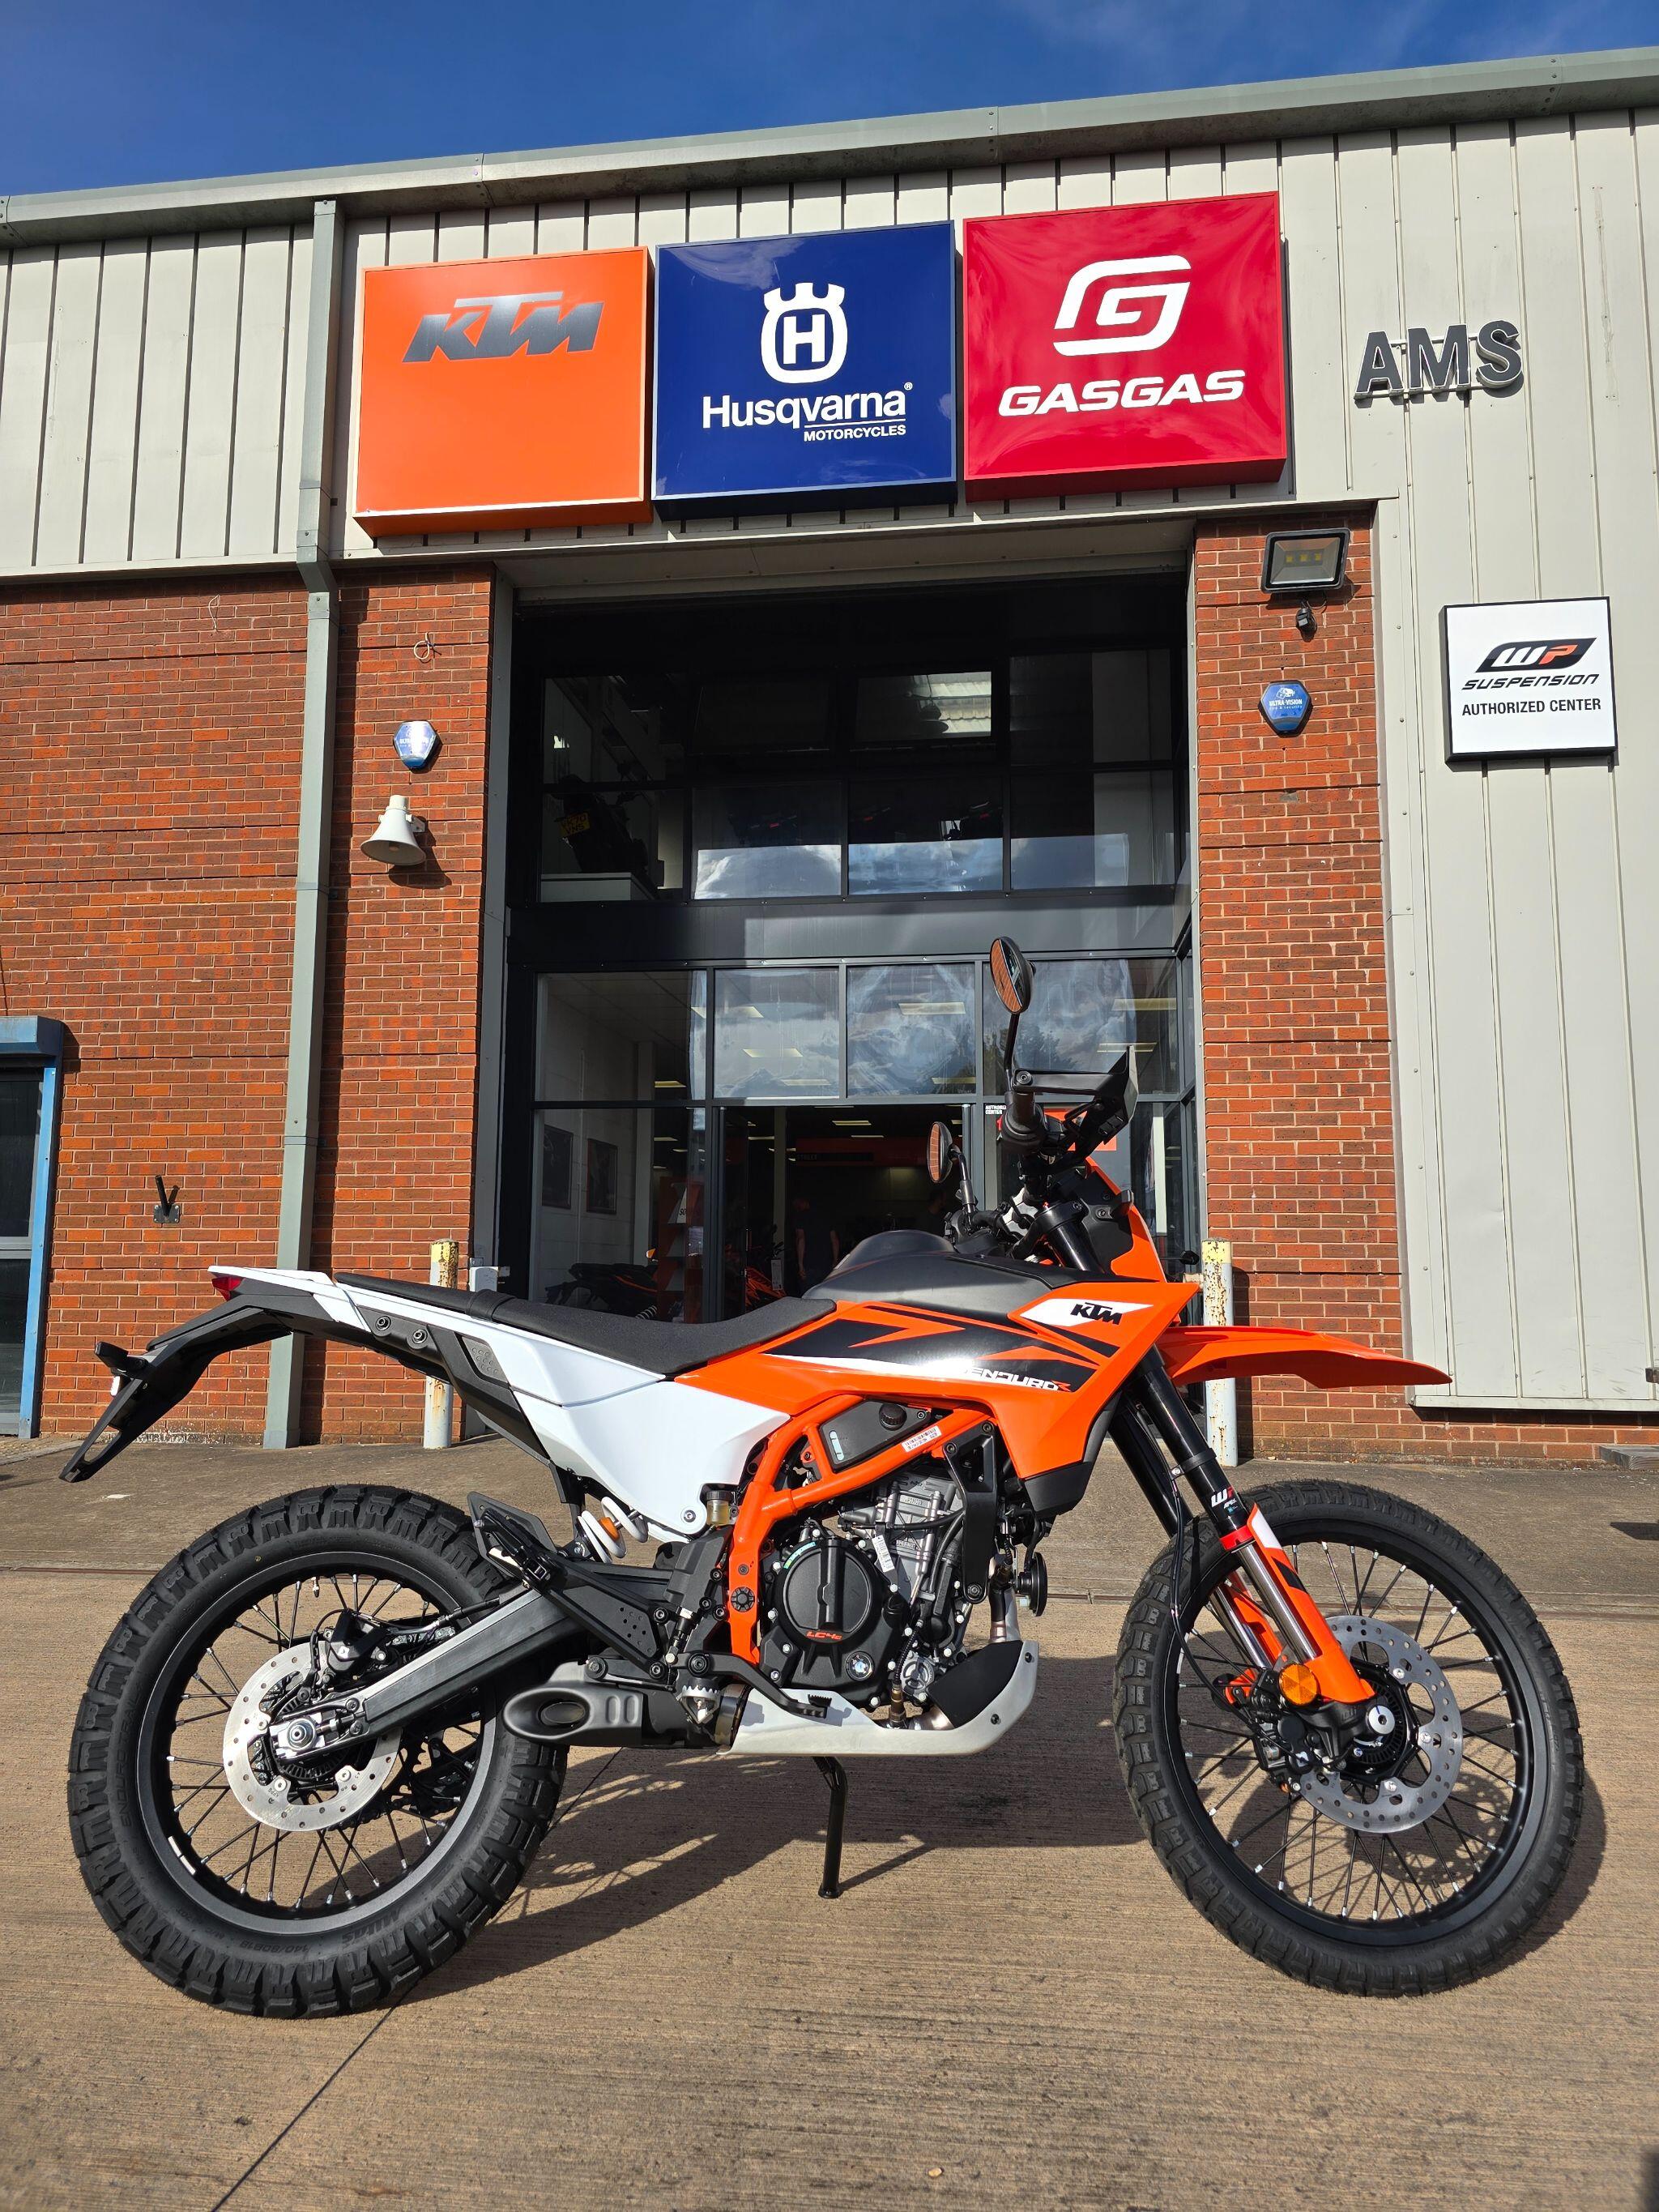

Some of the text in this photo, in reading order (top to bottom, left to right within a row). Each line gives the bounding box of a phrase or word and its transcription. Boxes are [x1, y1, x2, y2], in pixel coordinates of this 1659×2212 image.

[402, 291, 605, 363] KTM
[1354, 320, 1522, 397] AMS
[998, 369, 1246, 417] GASGAS
[804, 425, 906, 442] MOTORCYCLES
[1461, 673, 1600, 690] SUSPENSION
[1461, 698, 1601, 716] AUTHORIZED CENTER
[1069, 1302, 1124, 1326] KTM
